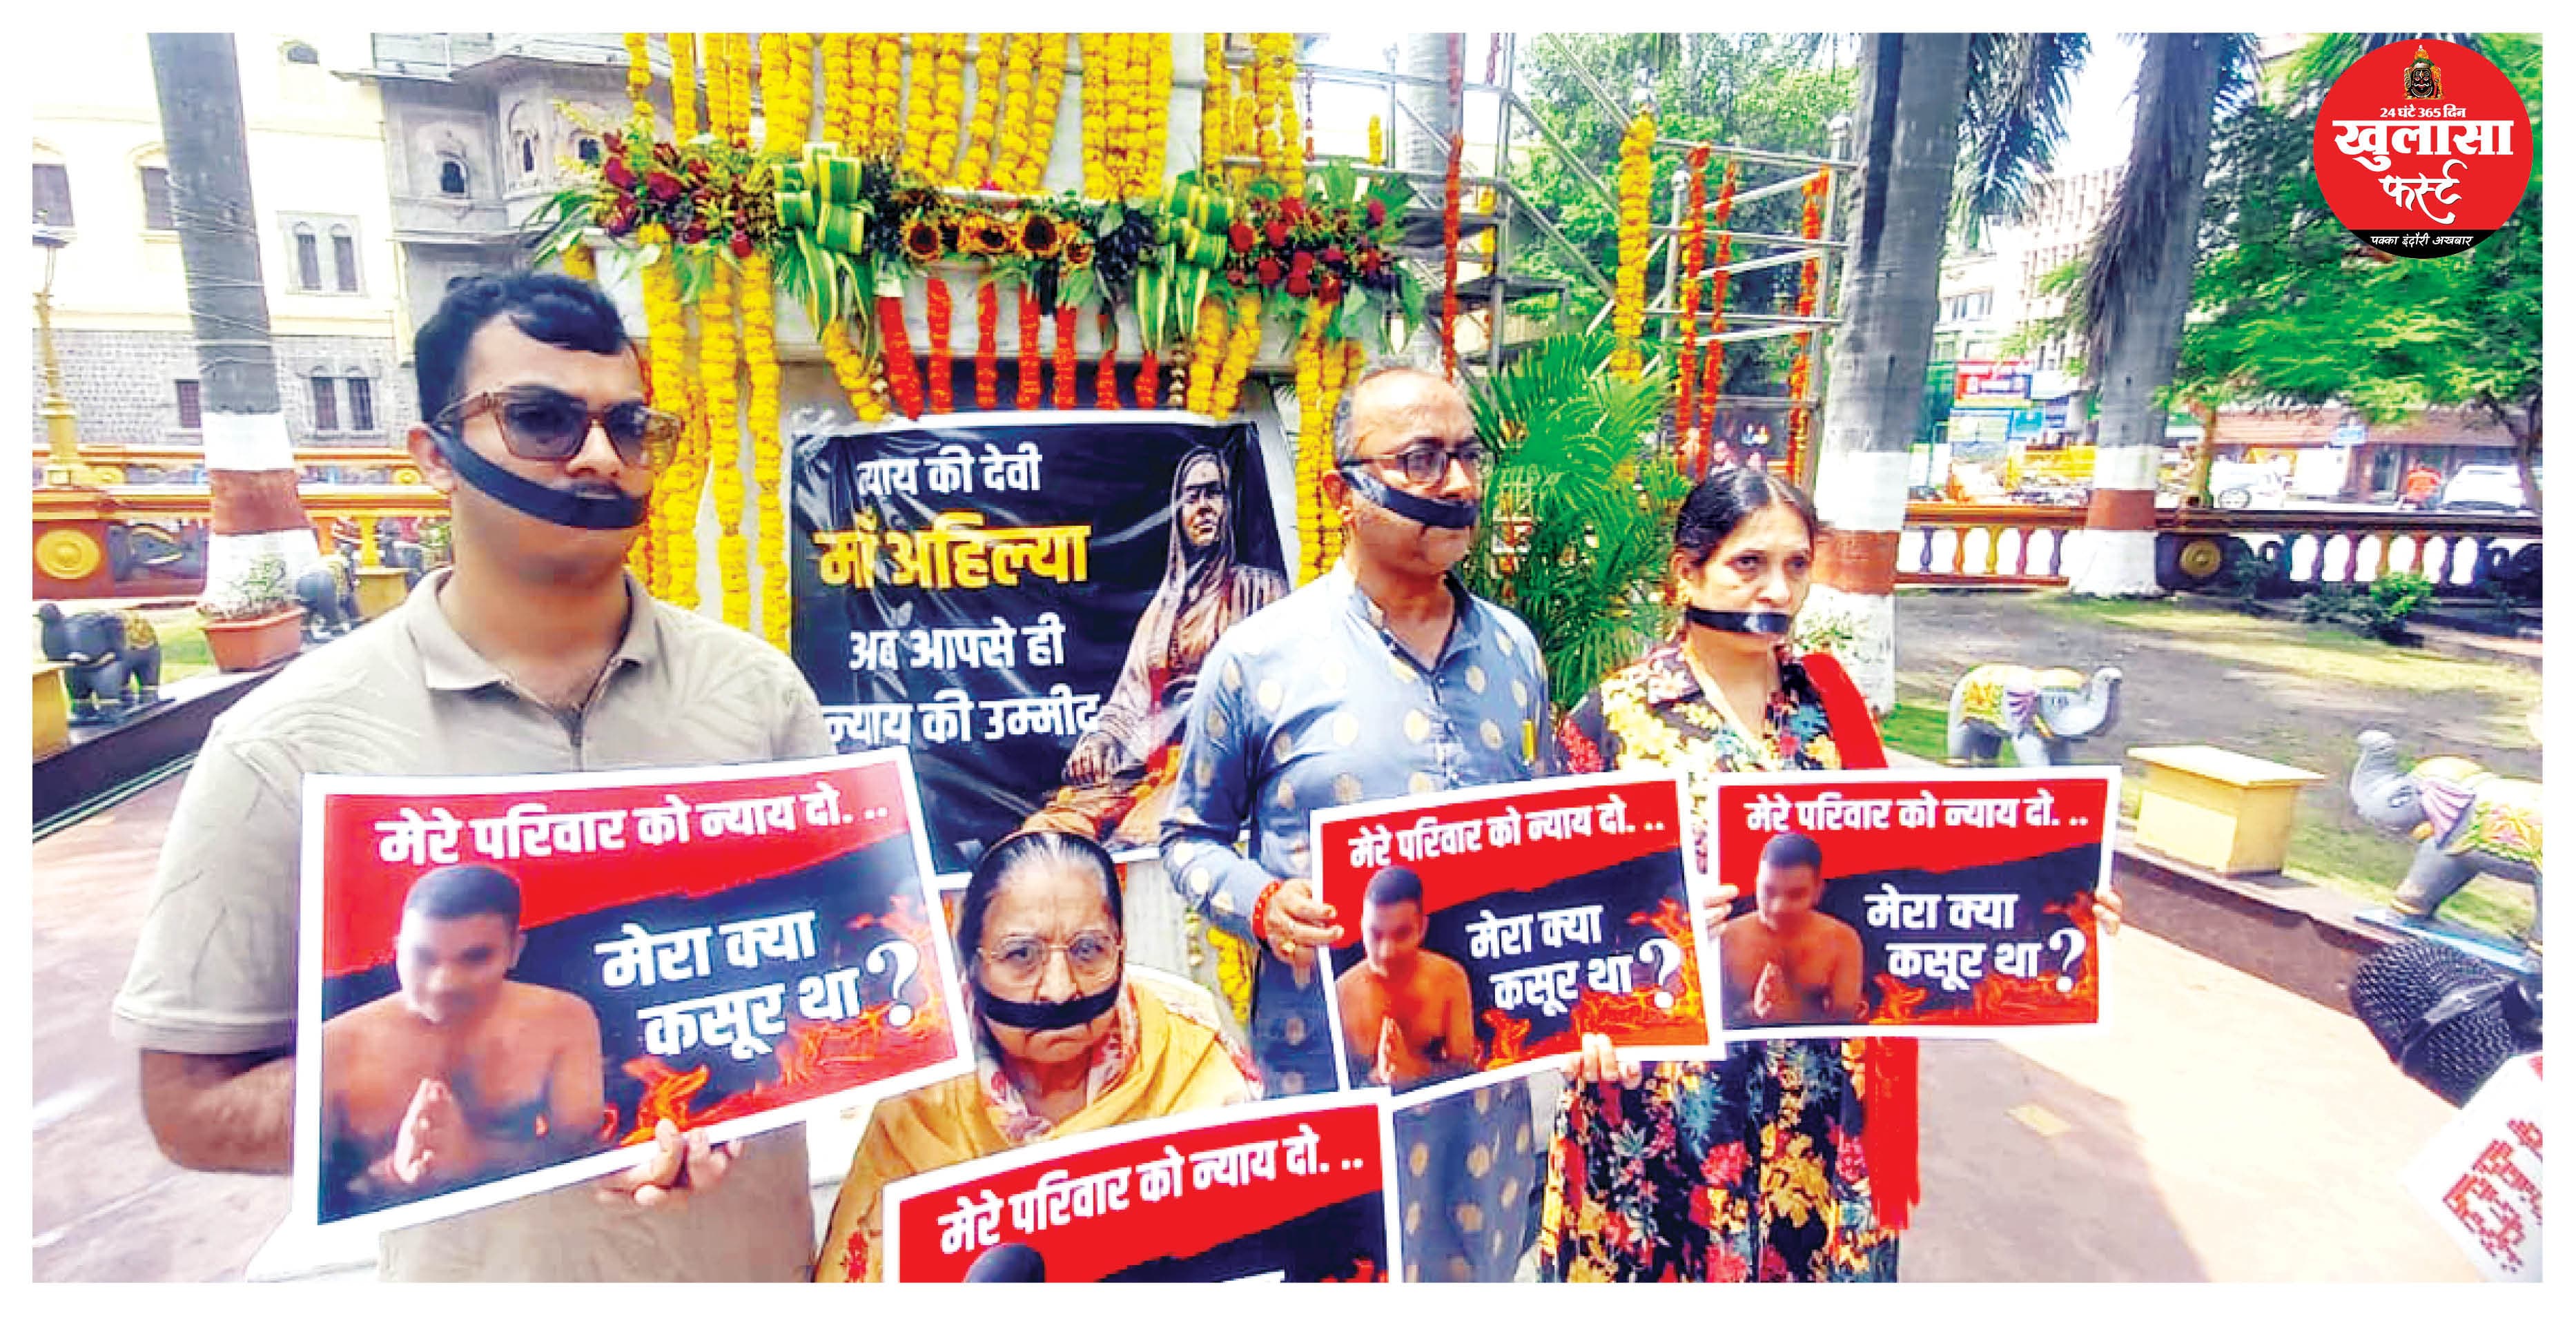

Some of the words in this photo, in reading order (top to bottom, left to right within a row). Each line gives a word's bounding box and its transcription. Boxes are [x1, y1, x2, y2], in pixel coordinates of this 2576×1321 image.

[924, 444, 974, 492] की
[979, 443, 1042, 490] देवी
[884, 513, 1091, 588] अहिल्या
[850, 630, 900, 670] अब
[910, 617, 1017, 669] आपसे
[1021, 612, 1066, 665] ही
[822, 701, 913, 745] न्याय
[917, 689, 974, 743] की
[375, 808, 464, 865] मेरे
[469, 803, 627, 859] परिवार
[632, 794, 692, 845] को
[696, 796, 795, 836] न्याय
[1349, 825, 1392, 868] मेरे
[1396, 816, 1482, 861] परिवार
[1487, 806, 1521, 848] को
[1525, 805, 1592, 841] न्याय
[1744, 794, 1791, 831] मेरे
[1795, 792, 1892, 830] परिवार
[1897, 790, 1939, 828] को
[1942, 799, 2020, 828] न्याय
[1465, 910, 1533, 958] मेरा
[1538, 906, 1603, 948] क्या
[1864, 883, 1941, 928] मेरा
[1946, 894, 2018, 928] क्या
[596, 923, 711, 987] मेरा
[719, 911, 814, 968] क्या
[1886, 943, 1987, 990] कसूर
[1490, 961, 1580, 1016] कसूर
[638, 991, 785, 1059] कसूर
[938, 1190, 1004, 1255] मेरे
[1008, 1167, 1131, 1233] परिवार
[1136, 1146, 1184, 1201] को
[1189, 1141, 1278, 1189] न्याय
